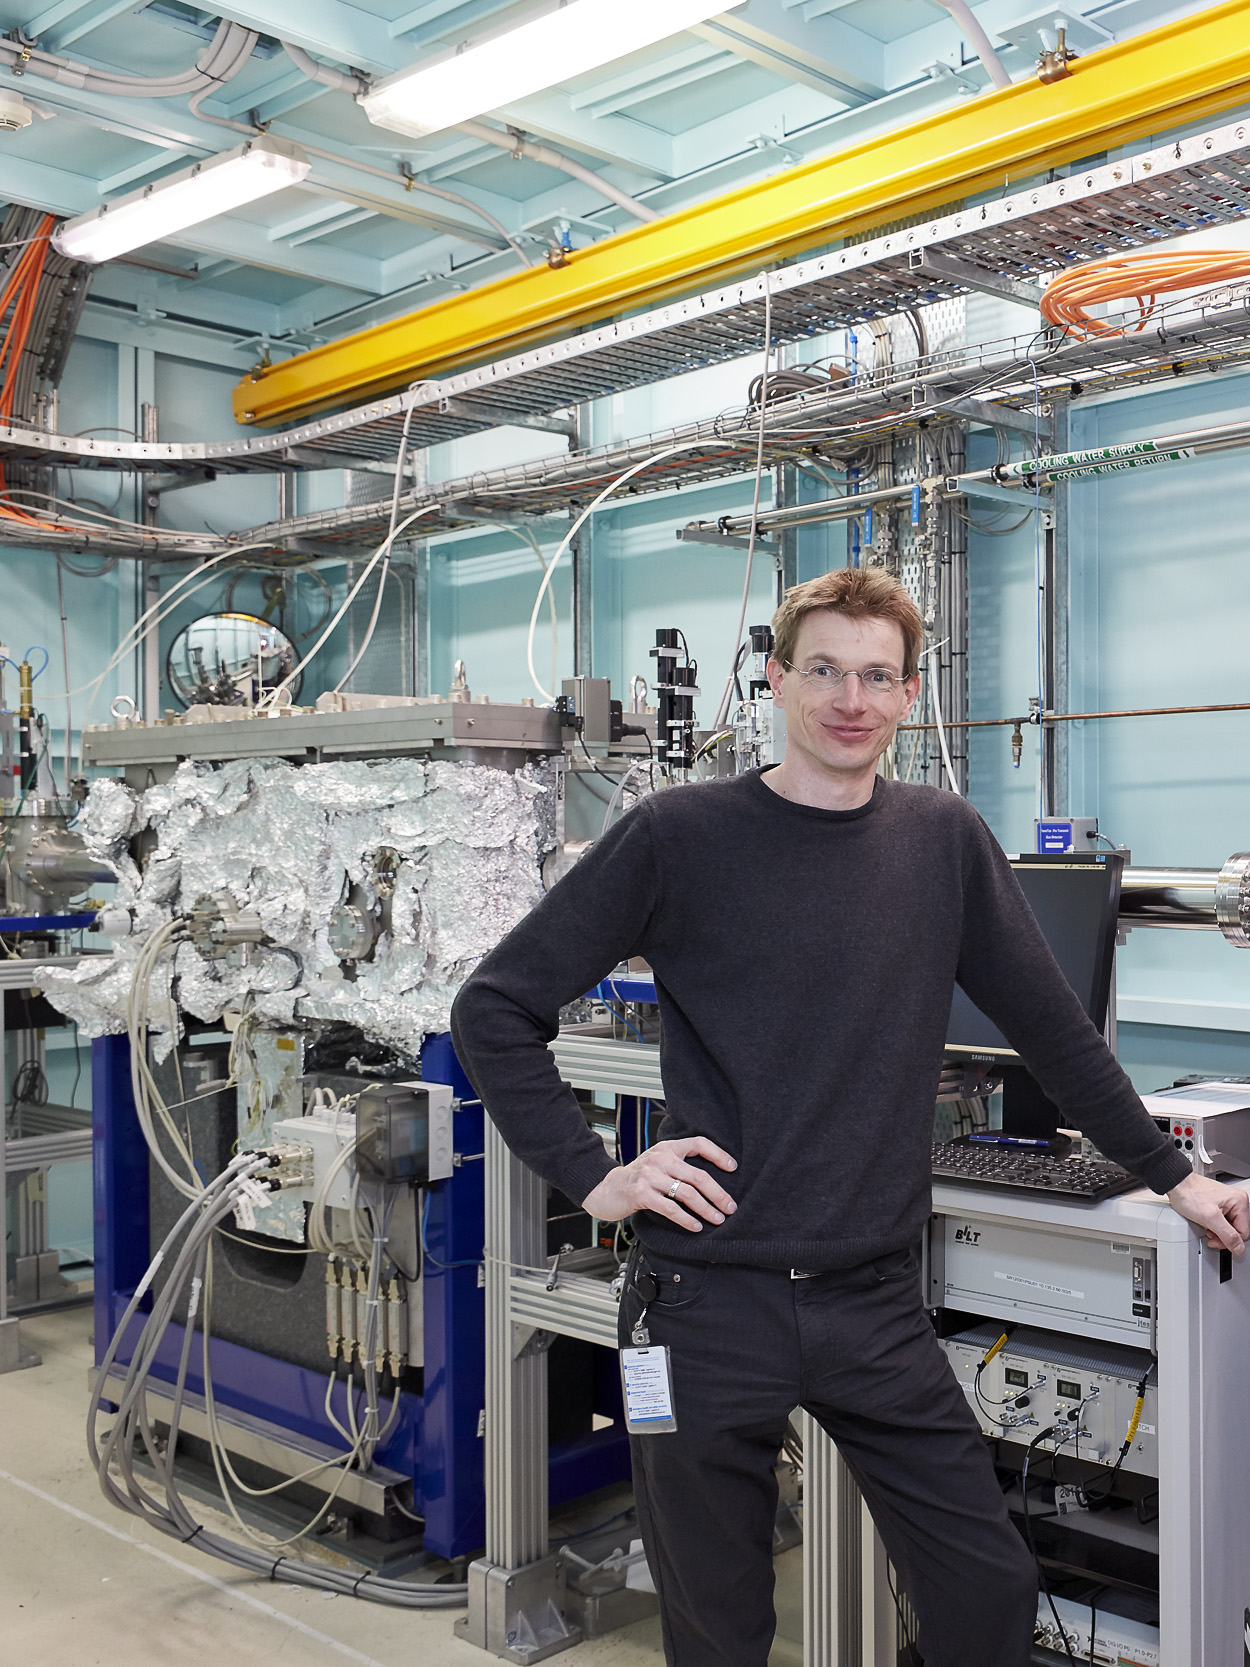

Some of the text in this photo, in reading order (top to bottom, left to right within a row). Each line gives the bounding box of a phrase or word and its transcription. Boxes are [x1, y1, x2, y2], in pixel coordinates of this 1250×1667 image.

[1029, 443, 1145, 471] COOLING WATER SUPPLY
[1056, 454, 1171, 481] COOLING WATER RETURN
[971, 1054, 996, 1062] SAMSUNG
